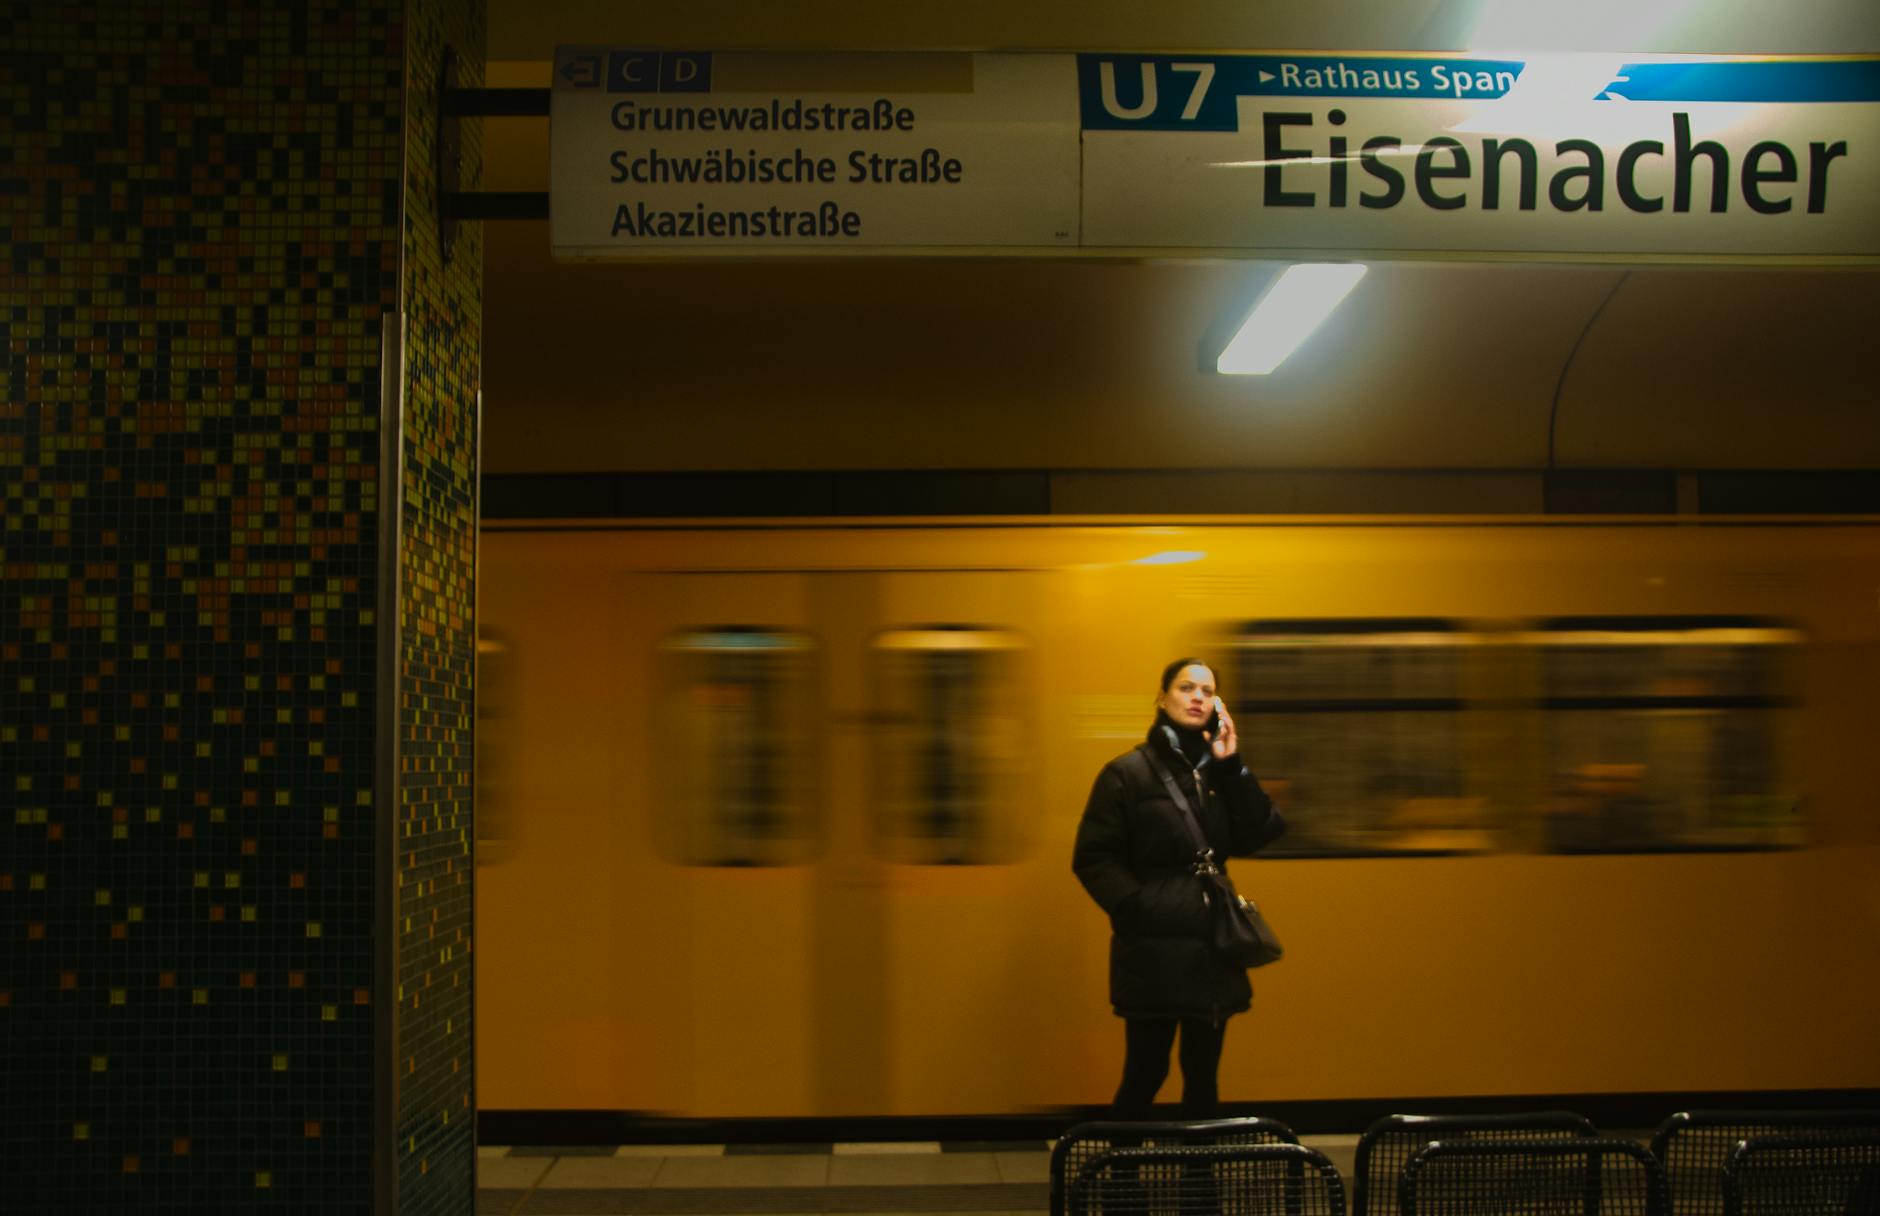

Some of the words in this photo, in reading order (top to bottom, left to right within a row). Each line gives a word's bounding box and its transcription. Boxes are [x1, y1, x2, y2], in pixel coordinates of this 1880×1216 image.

[622, 57, 645, 82] C
[673, 57, 698, 82] D
[1281, 63, 1421, 90] Rathaus
[1430, 65, 1517, 98] Span
[610, 100, 915, 131] Grunewaldstraße
[610, 149, 836, 184] Schwäbische
[848, 149, 963, 184] Straße
[1263, 109, 1848, 215] Eisenacher
[611, 202, 861, 238] Akazienstraße
